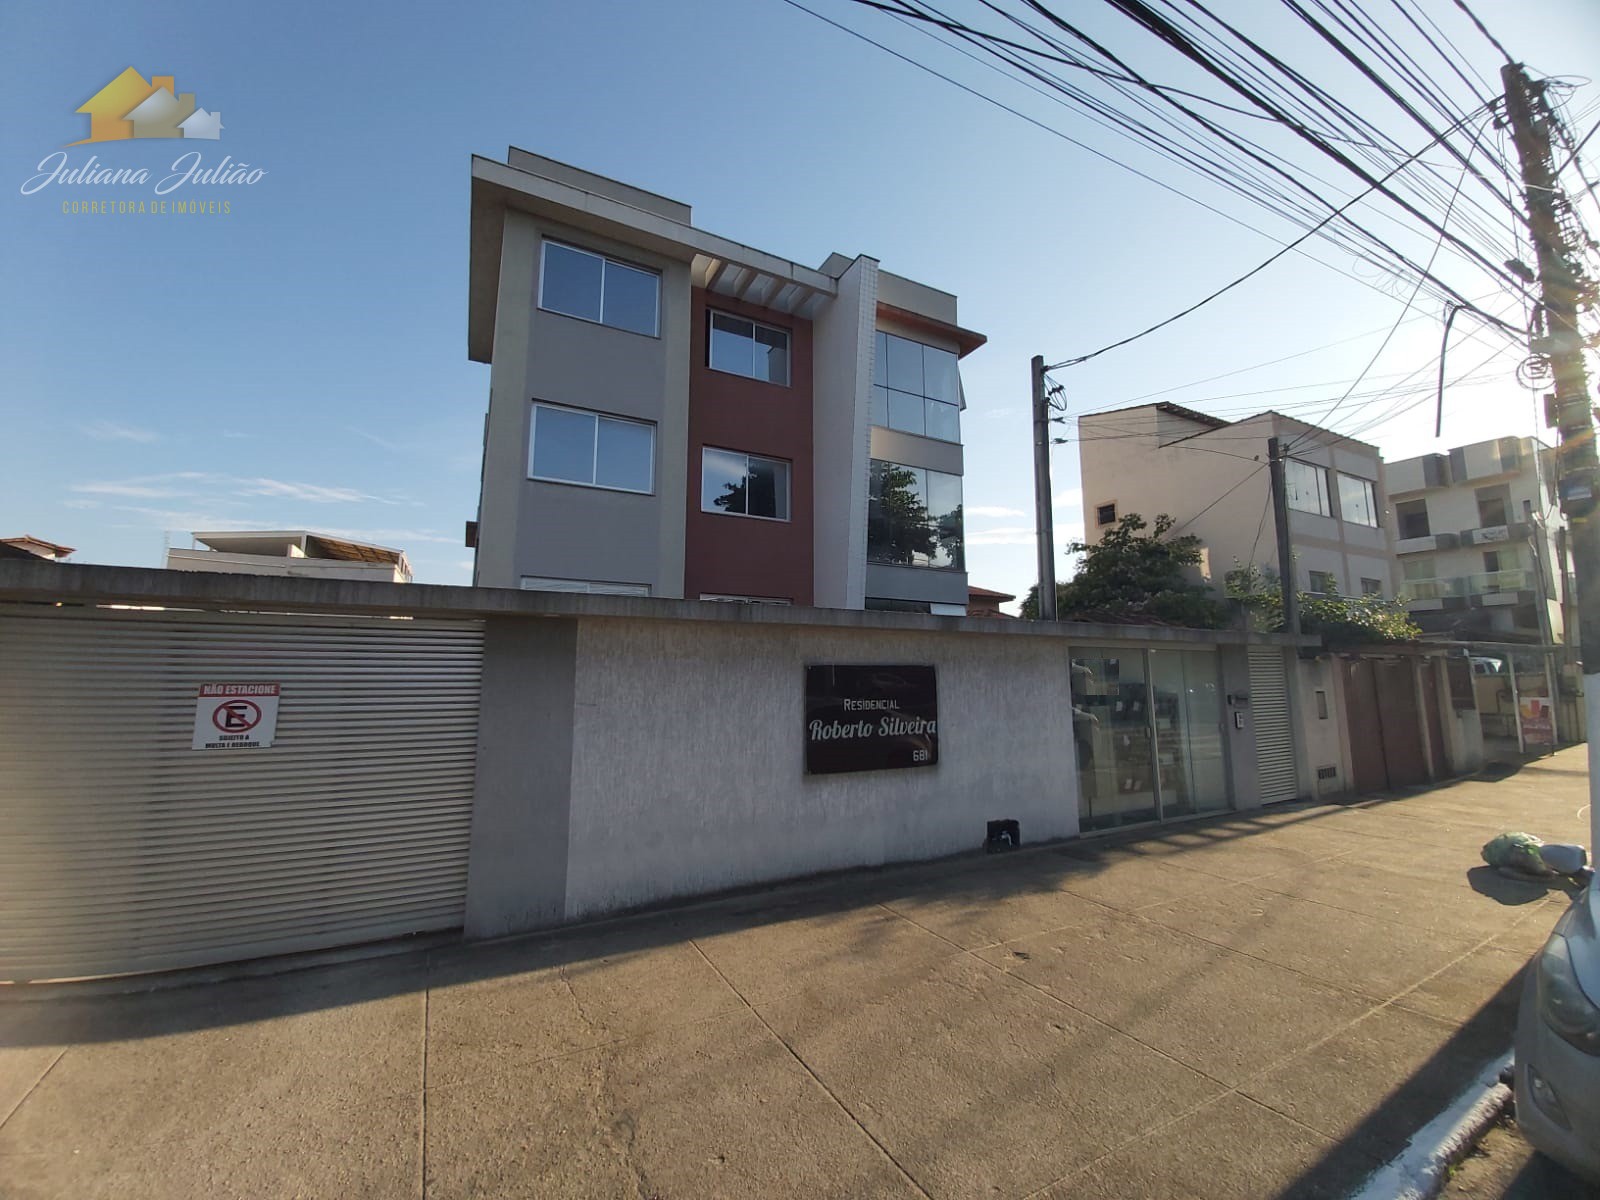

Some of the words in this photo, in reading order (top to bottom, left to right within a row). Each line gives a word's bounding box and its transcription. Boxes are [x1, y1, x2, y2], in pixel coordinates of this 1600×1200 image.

[203, 682, 224, 695] NÃO
[225, 684, 277, 695] ESTACIONE
[843, 698, 900, 711] RESIDENCIAL
[808, 719, 874, 741] Roberto
[878, 716, 937, 737] Silveira
